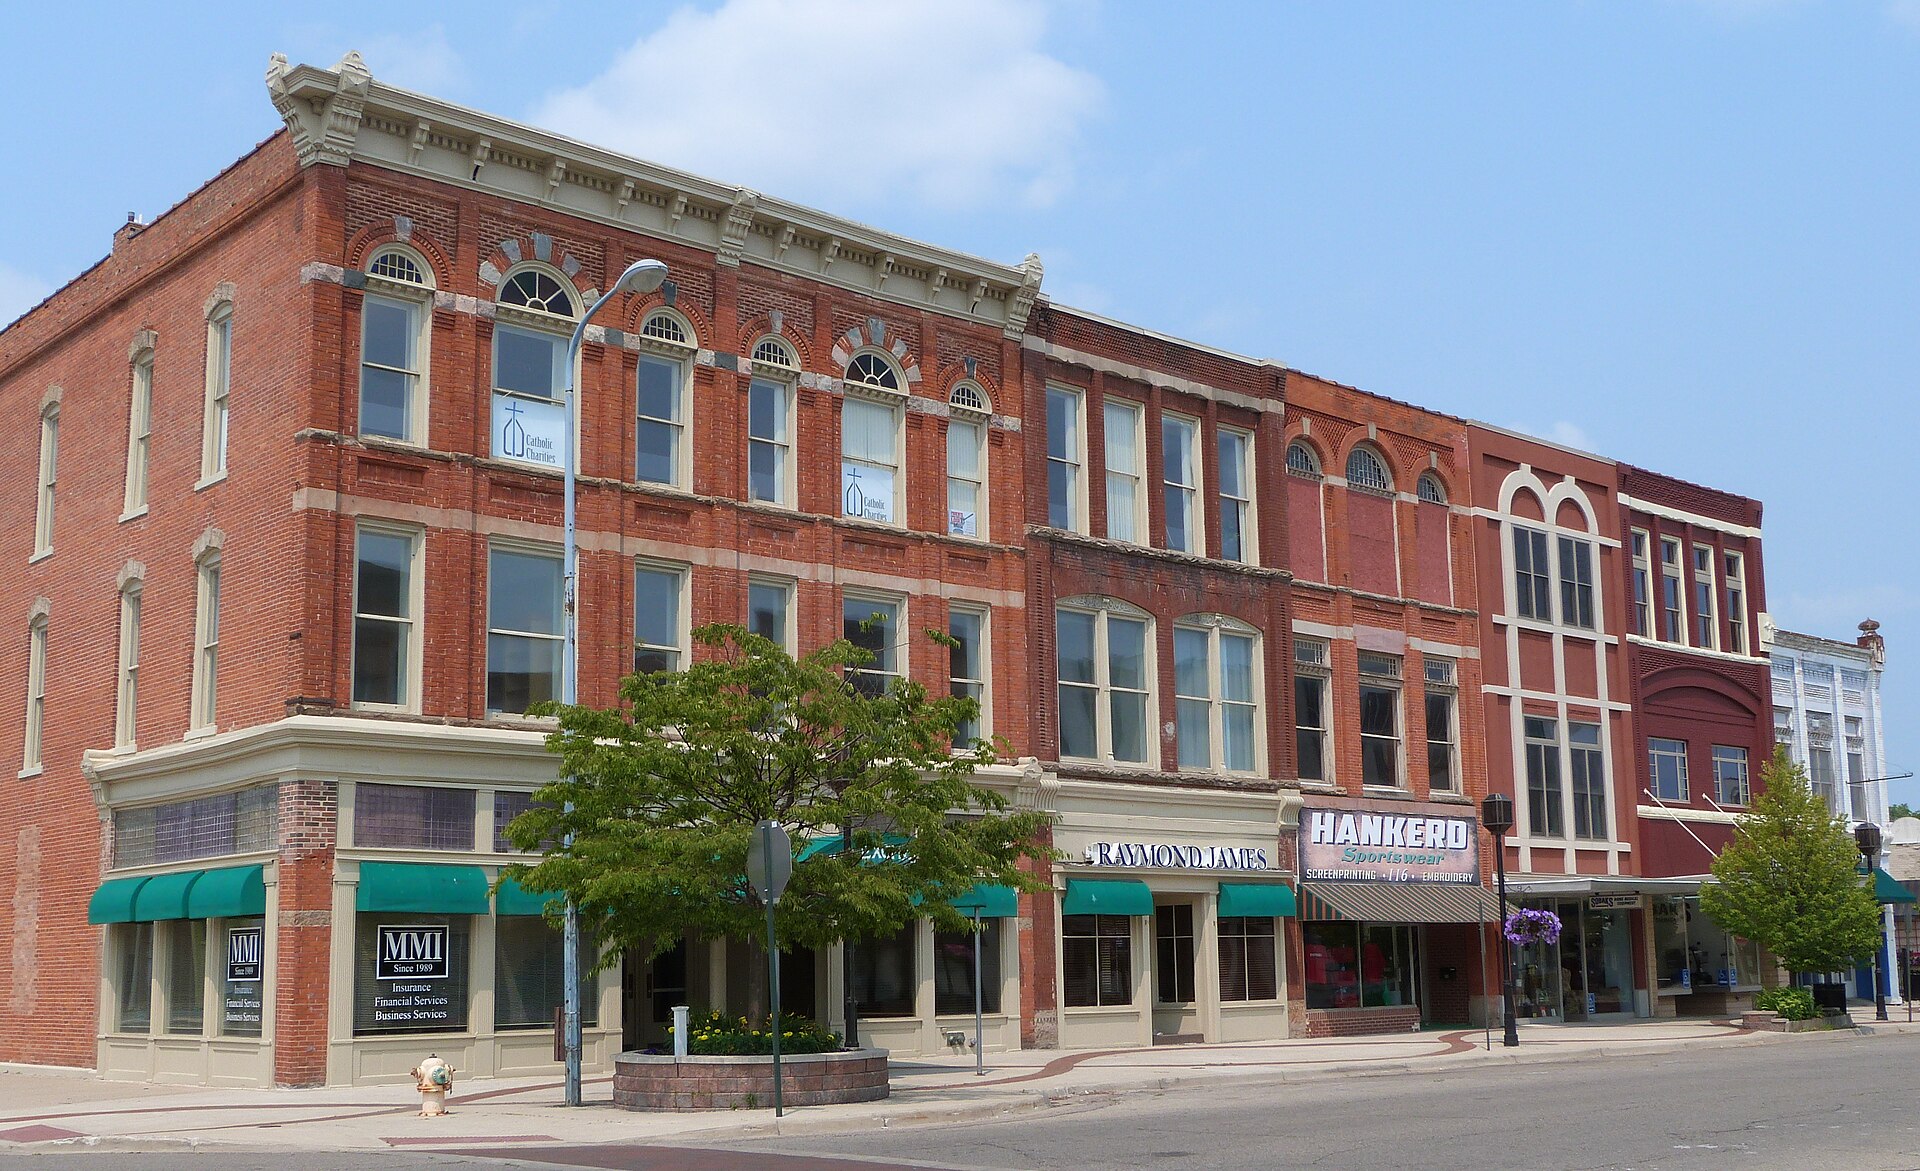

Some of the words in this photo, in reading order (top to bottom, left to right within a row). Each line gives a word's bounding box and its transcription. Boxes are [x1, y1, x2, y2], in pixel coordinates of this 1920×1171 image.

[526, 434, 553, 449] Catholic
[526, 447, 556, 463] Charities
[864, 496, 885, 509] Catholic
[1311, 812, 1469, 850] HANKERD
[1096, 841, 1203, 869] RAYMOND
[1206, 846, 1268, 871] JAMES
[1342, 847, 1445, 866] Sportswear
[1306, 868, 1377, 880] SCREENPRINTING
[1422, 871, 1474, 883] EMBROIDERY
[231, 935, 259, 963] MMI
[384, 932, 442, 960] MMI
[393, 964, 414, 973] Since
[416, 963, 433, 973] 1989
[392, 982, 432, 993] Insurance
[226, 998, 243, 1008] Financial
[244, 998, 260, 1008] Services
[374, 996, 412, 1007] Financial
[414, 995, 448, 1006] Services
[226, 1011, 243, 1021] Business
[243, 1012, 260, 1022] Services
[375, 1009, 412, 1020] Business
[413, 1008, 447, 1019] Services
